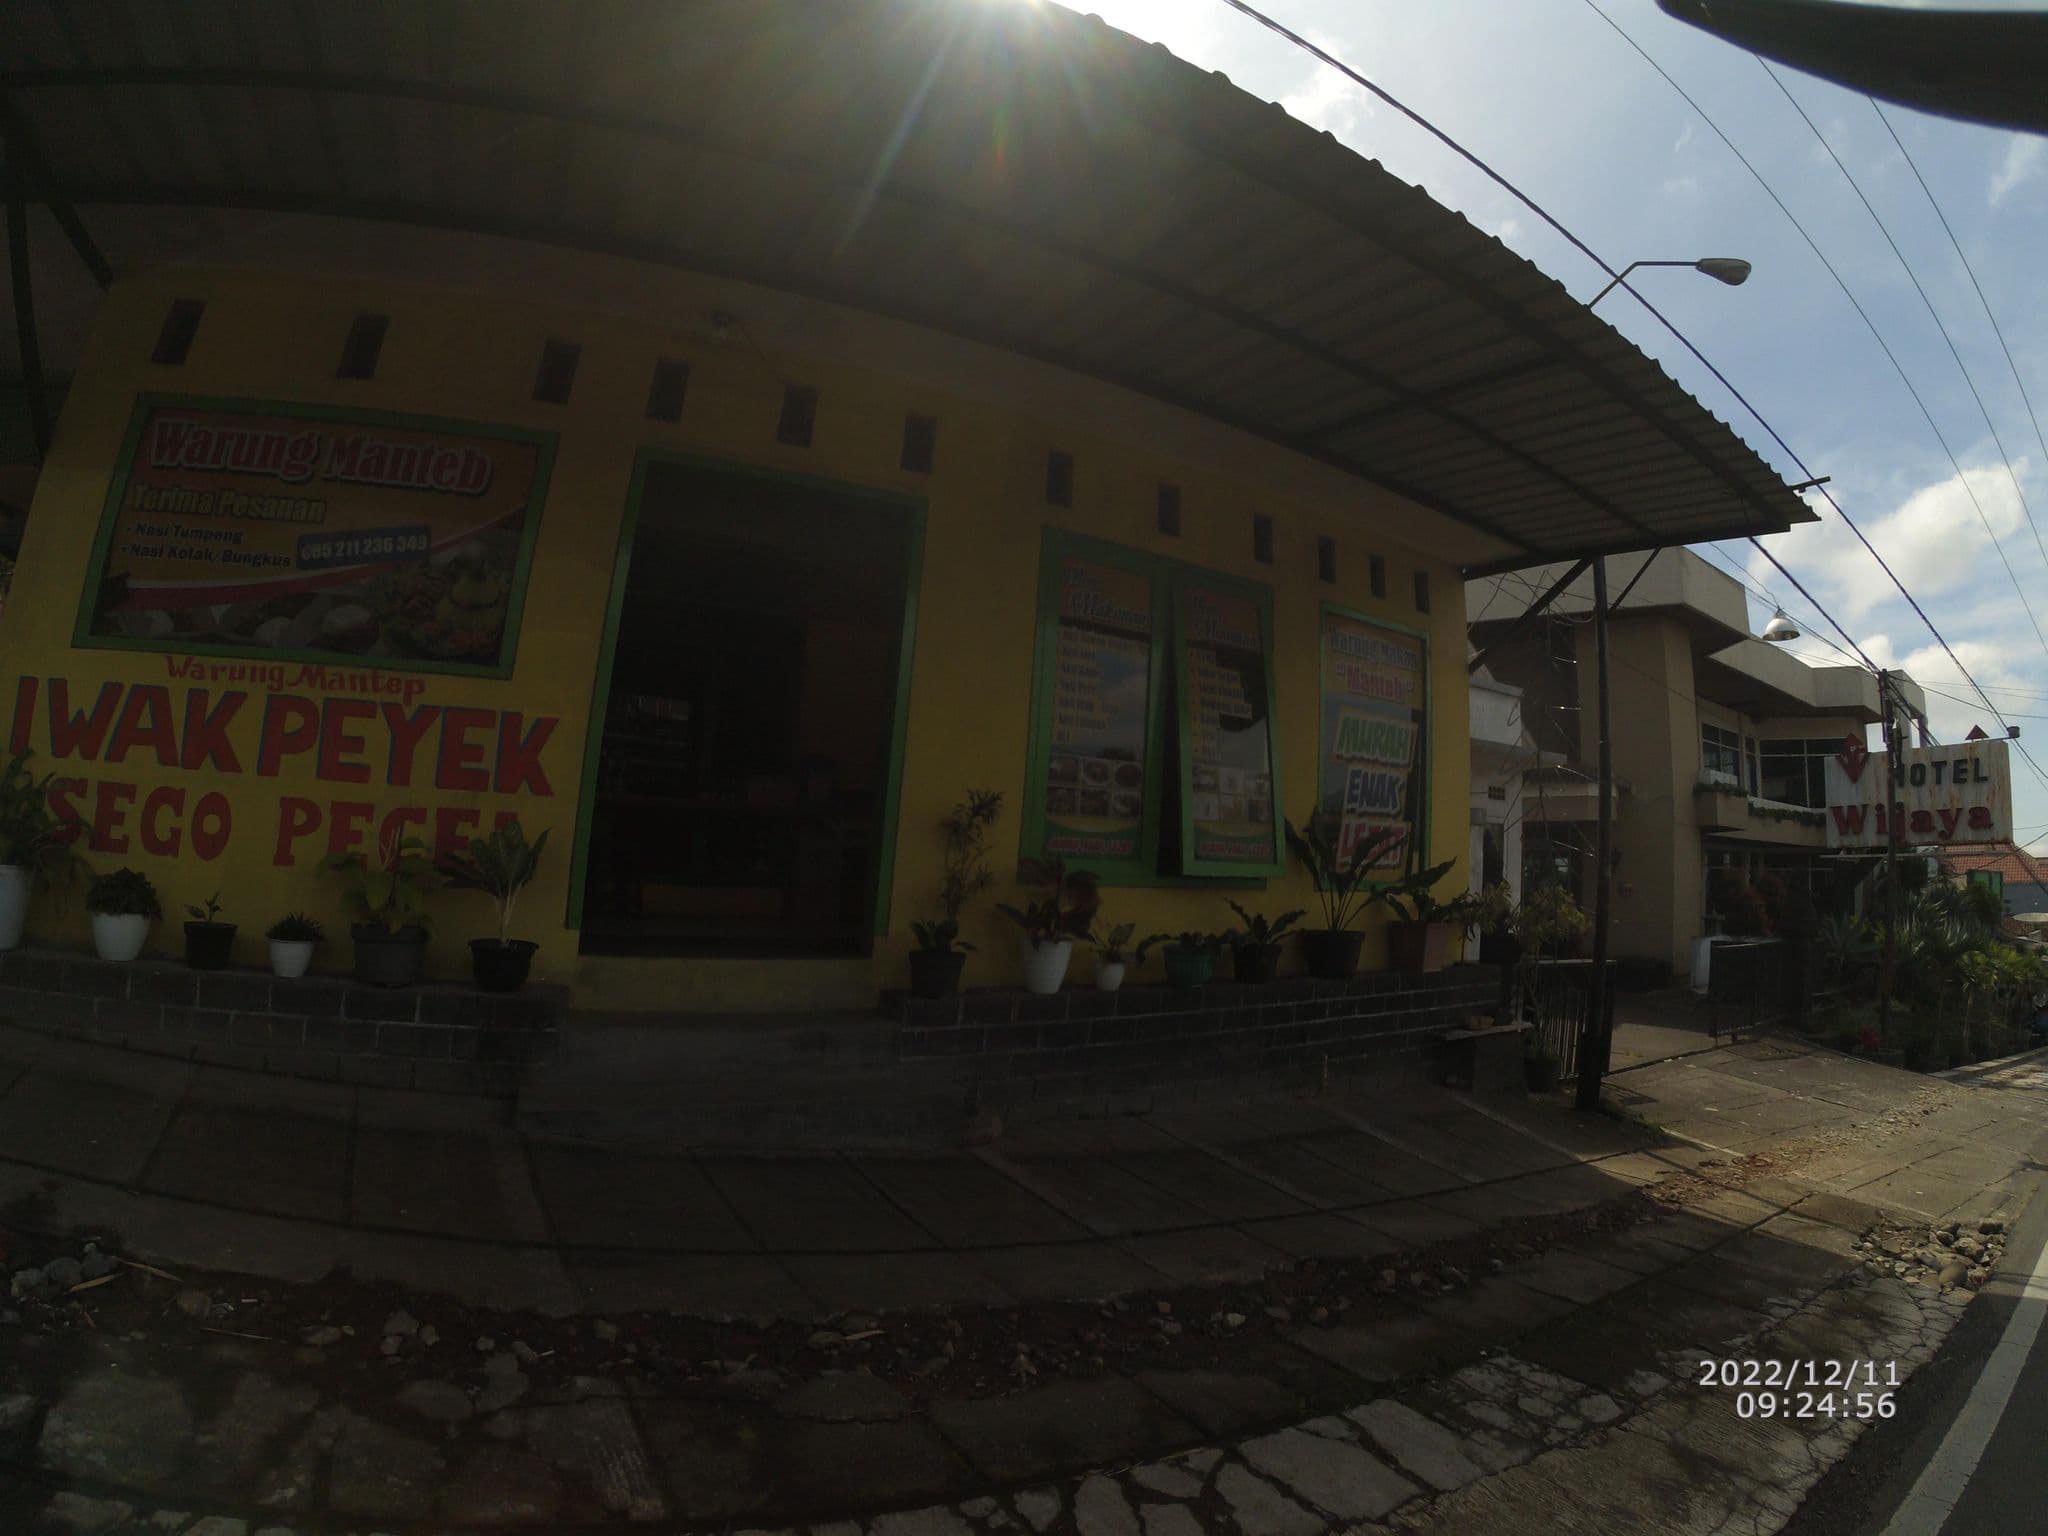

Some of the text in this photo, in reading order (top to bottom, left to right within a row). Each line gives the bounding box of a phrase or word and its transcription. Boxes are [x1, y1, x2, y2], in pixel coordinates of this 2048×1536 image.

[152, 419, 493, 493] Warung Manteb
[130, 485, 326, 522] Terima Pesanan
[136, 523, 169, 537] Nasi
[129, 543, 162, 557] Nasi
[222, 549, 291, 568] Bungkus
[166, 655, 426, 705] Warung Mantep
[256, 693, 559, 797] PEYEK
[1347, 768, 1400, 812] ENAK
[47, 777, 520, 873] SEGO PECE
